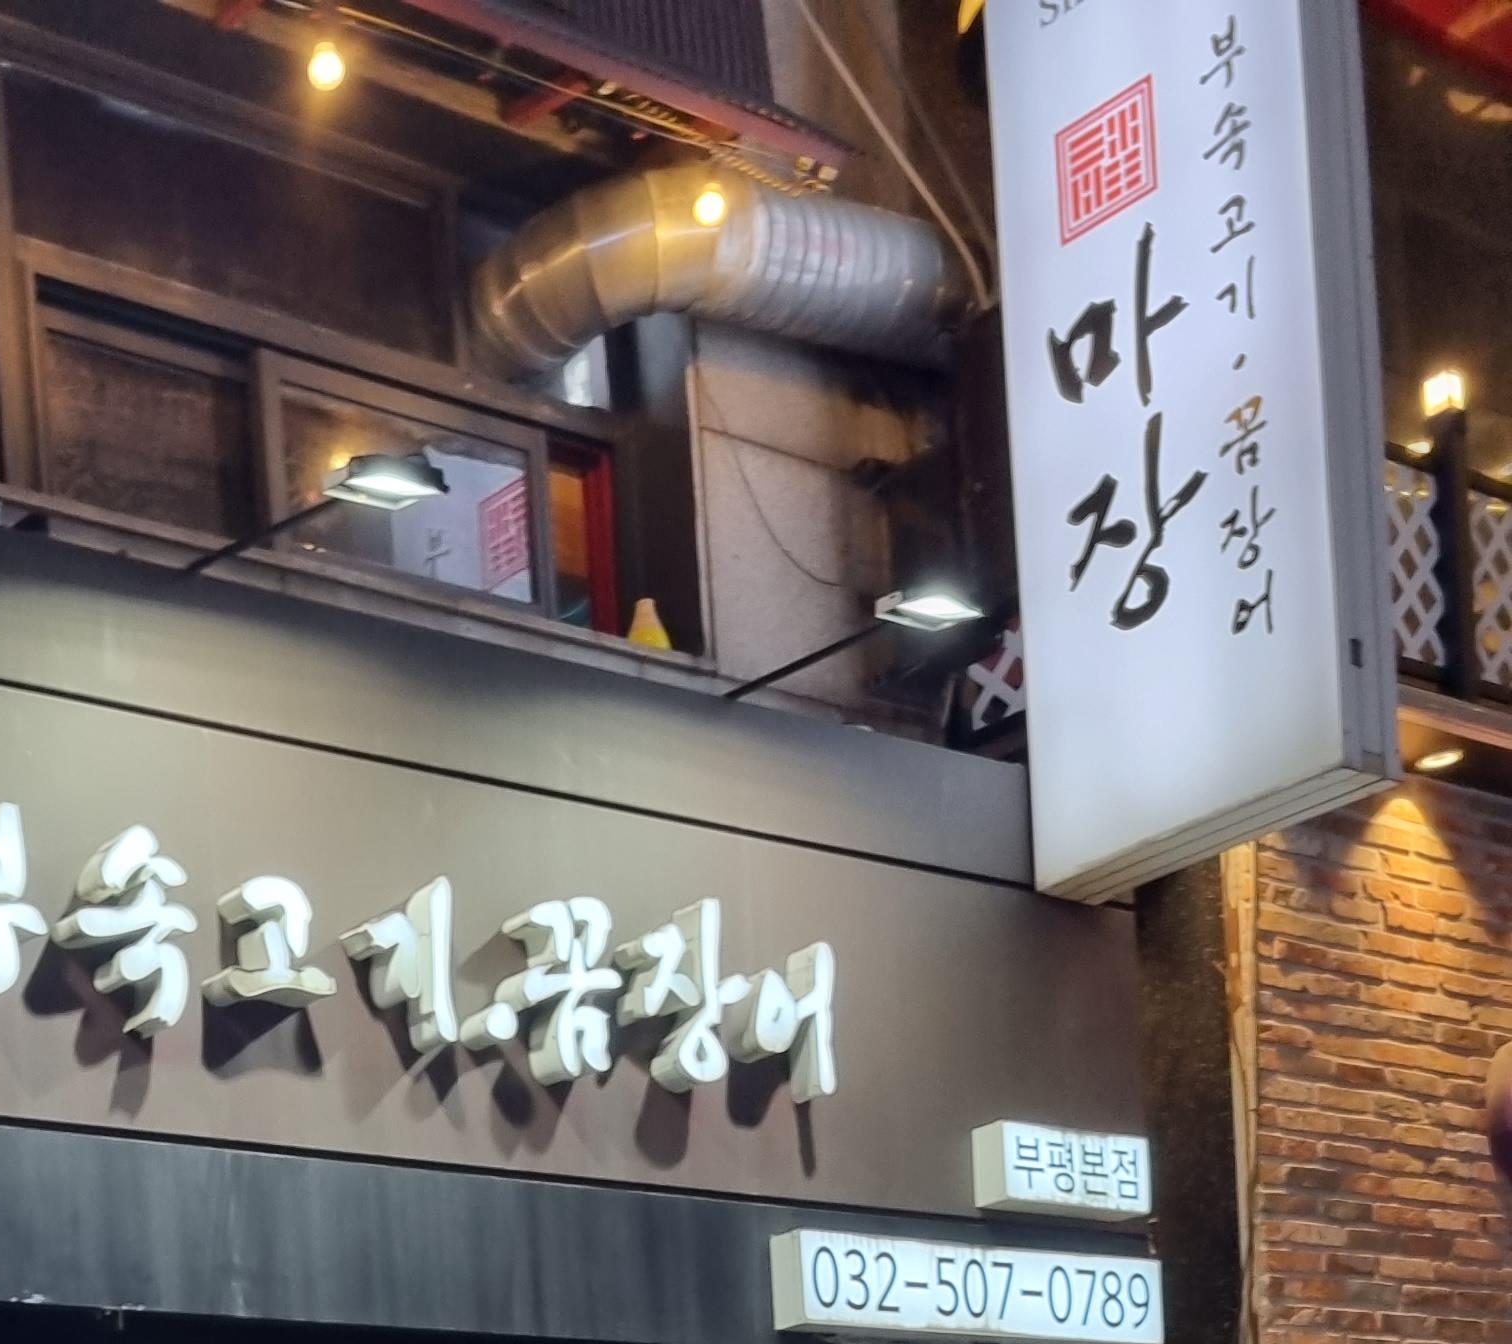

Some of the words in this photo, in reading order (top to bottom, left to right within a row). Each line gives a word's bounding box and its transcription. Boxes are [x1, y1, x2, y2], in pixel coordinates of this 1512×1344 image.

[1046, 222, 1208, 632] 마장
[1013, 1135, 1140, 1199] 부평본점
[811, 1246, 1151, 1329] 032-507-0789
